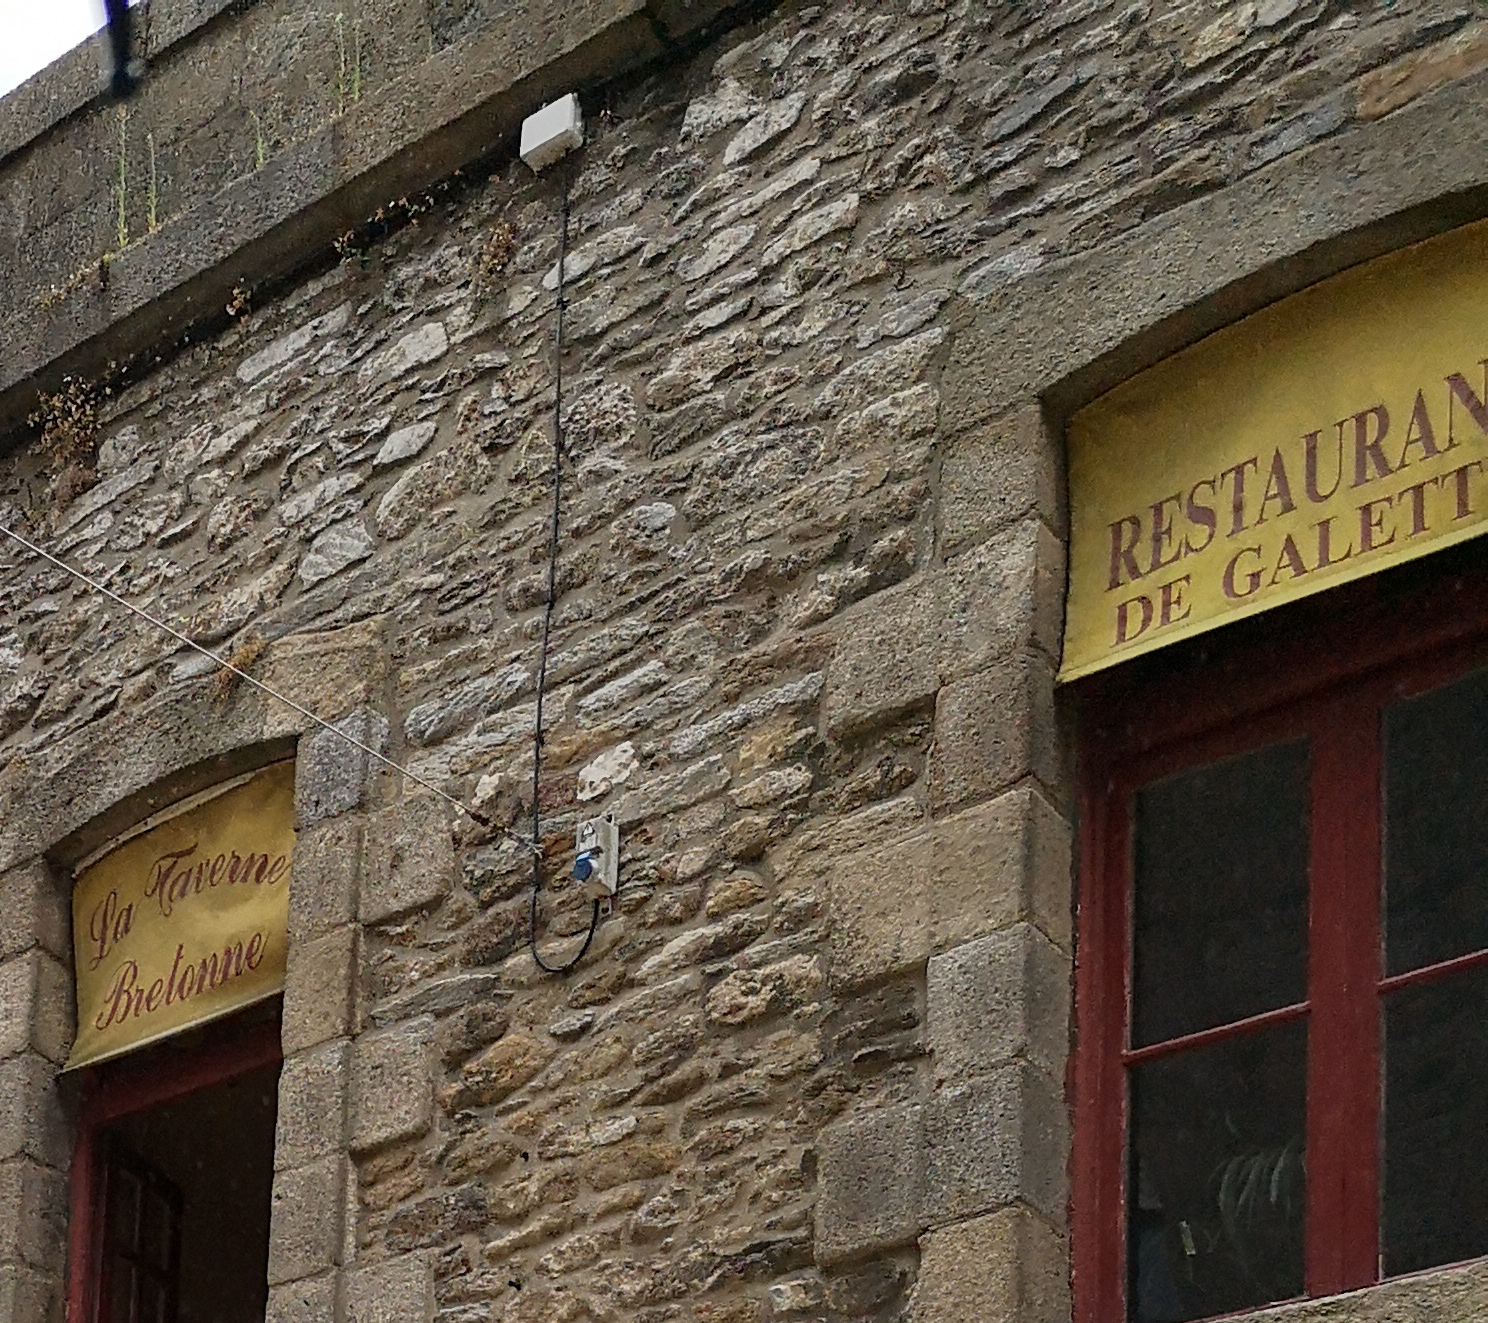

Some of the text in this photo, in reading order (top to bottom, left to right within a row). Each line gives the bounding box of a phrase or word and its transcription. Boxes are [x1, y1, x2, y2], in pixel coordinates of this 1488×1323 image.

[1114, 460, 1486, 645] DE GALETT
[89, 842, 291, 971] La Taverne
[95, 931, 272, 1030] Bretonne
